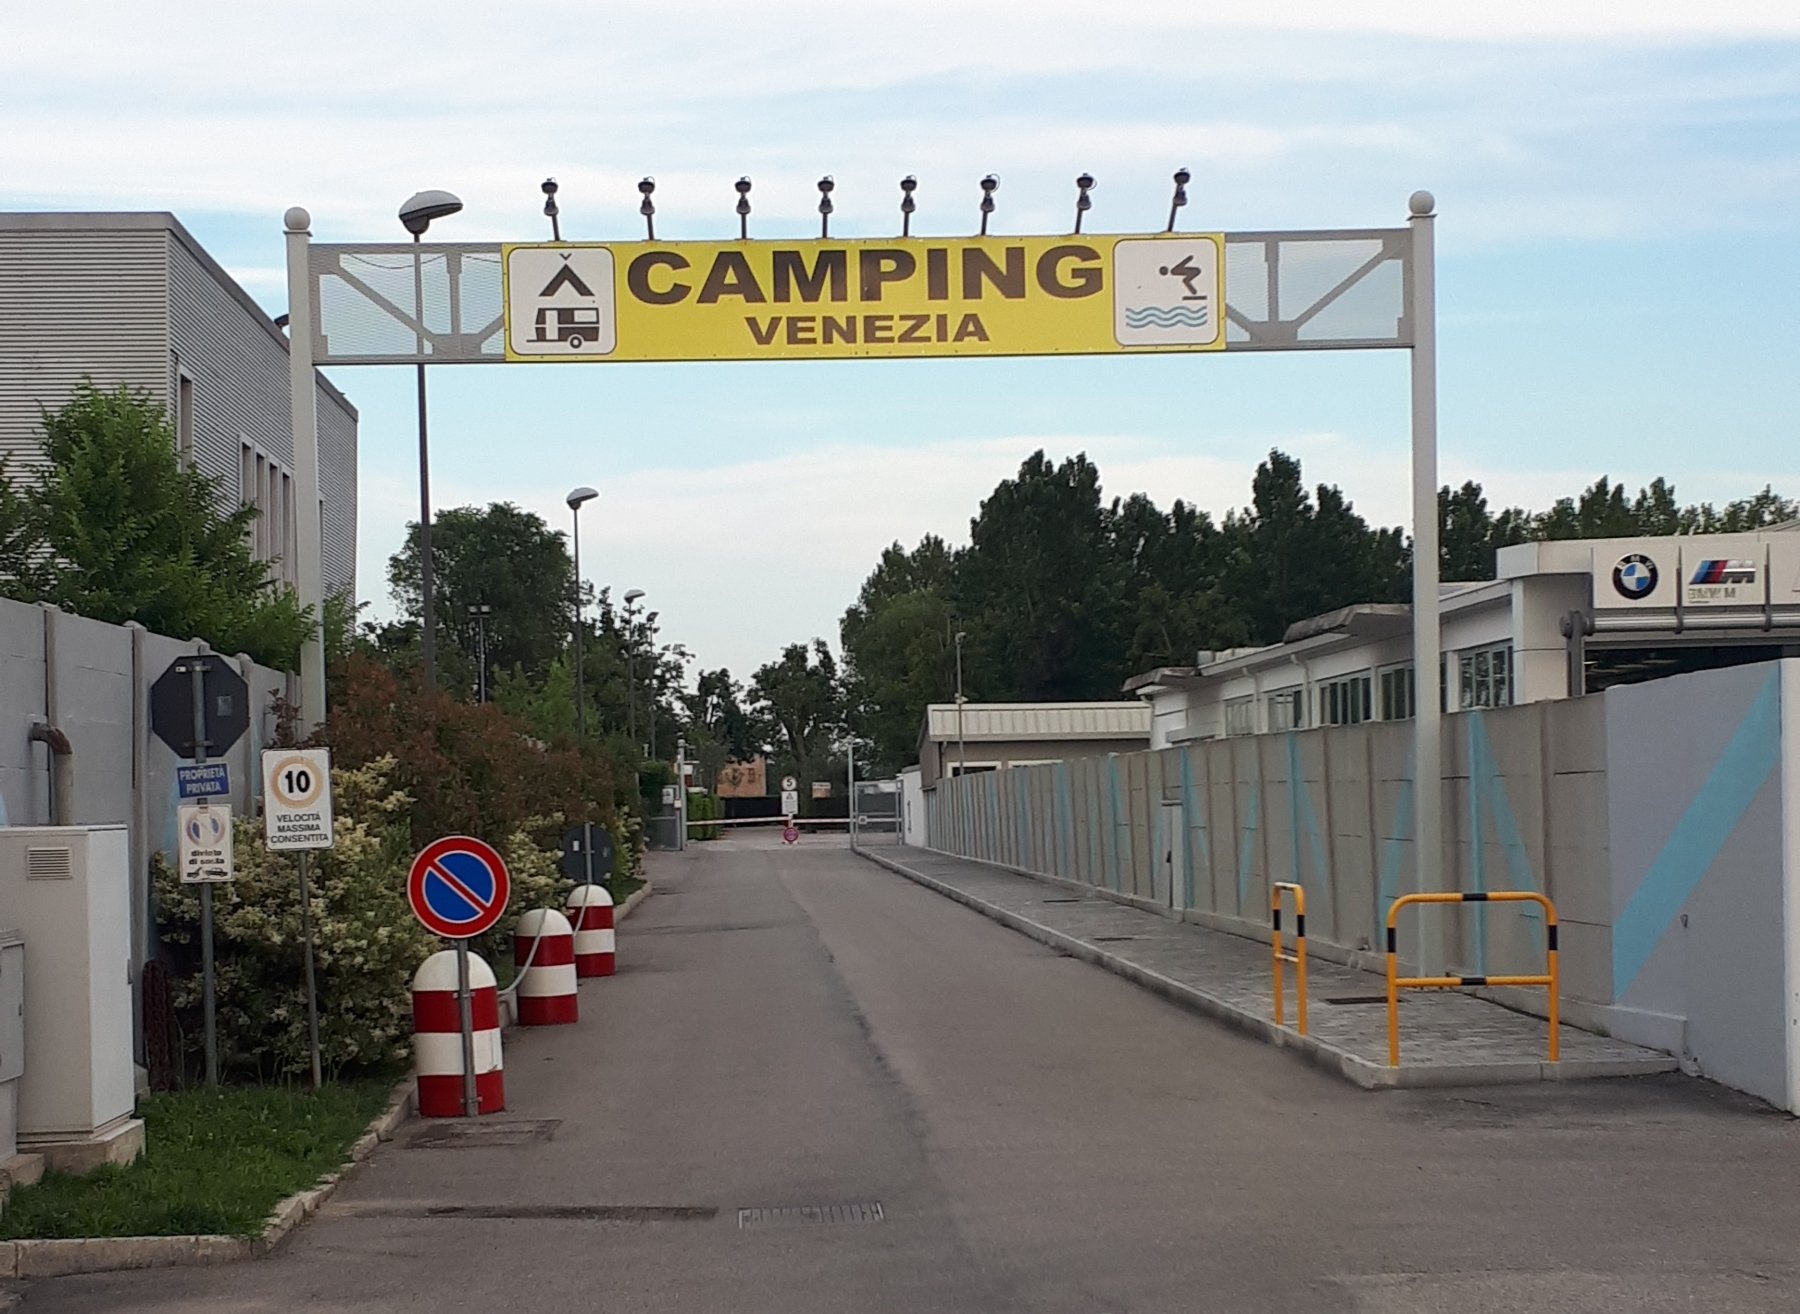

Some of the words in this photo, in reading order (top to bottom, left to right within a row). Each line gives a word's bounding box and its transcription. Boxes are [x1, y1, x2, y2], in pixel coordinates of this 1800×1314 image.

[626, 246, 1104, 305] CAMPING
[745, 312, 991, 346] VENEZIA
[186, 781, 222, 794] PRIVATA
[285, 770, 310, 793] 10
[277, 823, 321, 833] MASSIMA
[270, 833, 329, 844] CONSENTITA
